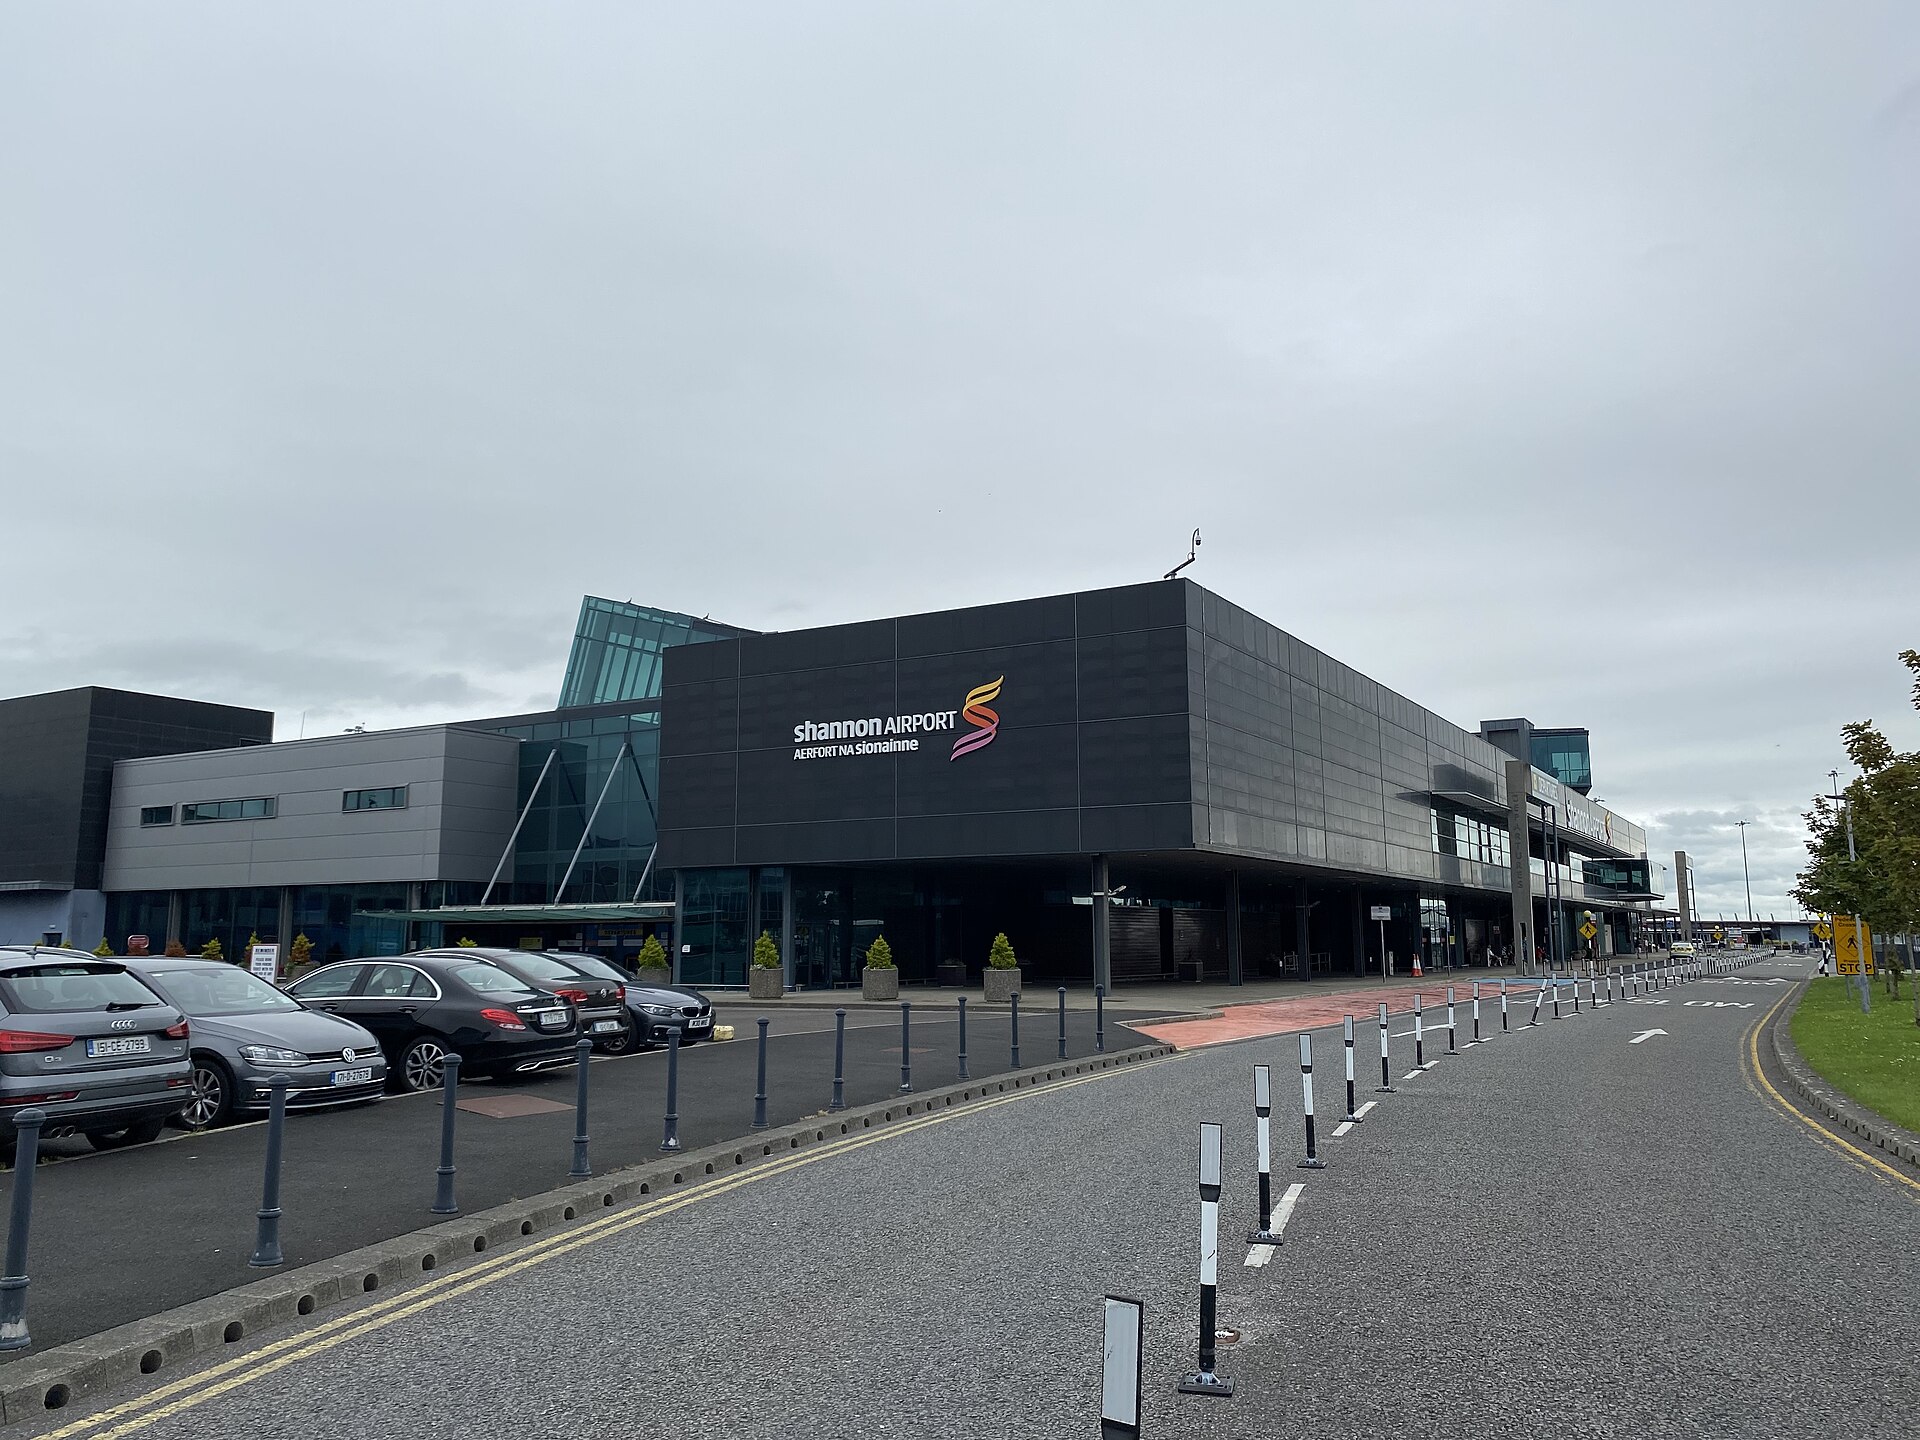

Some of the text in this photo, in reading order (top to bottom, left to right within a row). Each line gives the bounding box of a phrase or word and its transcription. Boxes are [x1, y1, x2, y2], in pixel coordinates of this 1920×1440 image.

[793, 710, 958, 743] shannon AIRPORT
[794, 739, 918, 761] AERFORT NA sionainne
[1839, 963, 1872, 973] STOP
